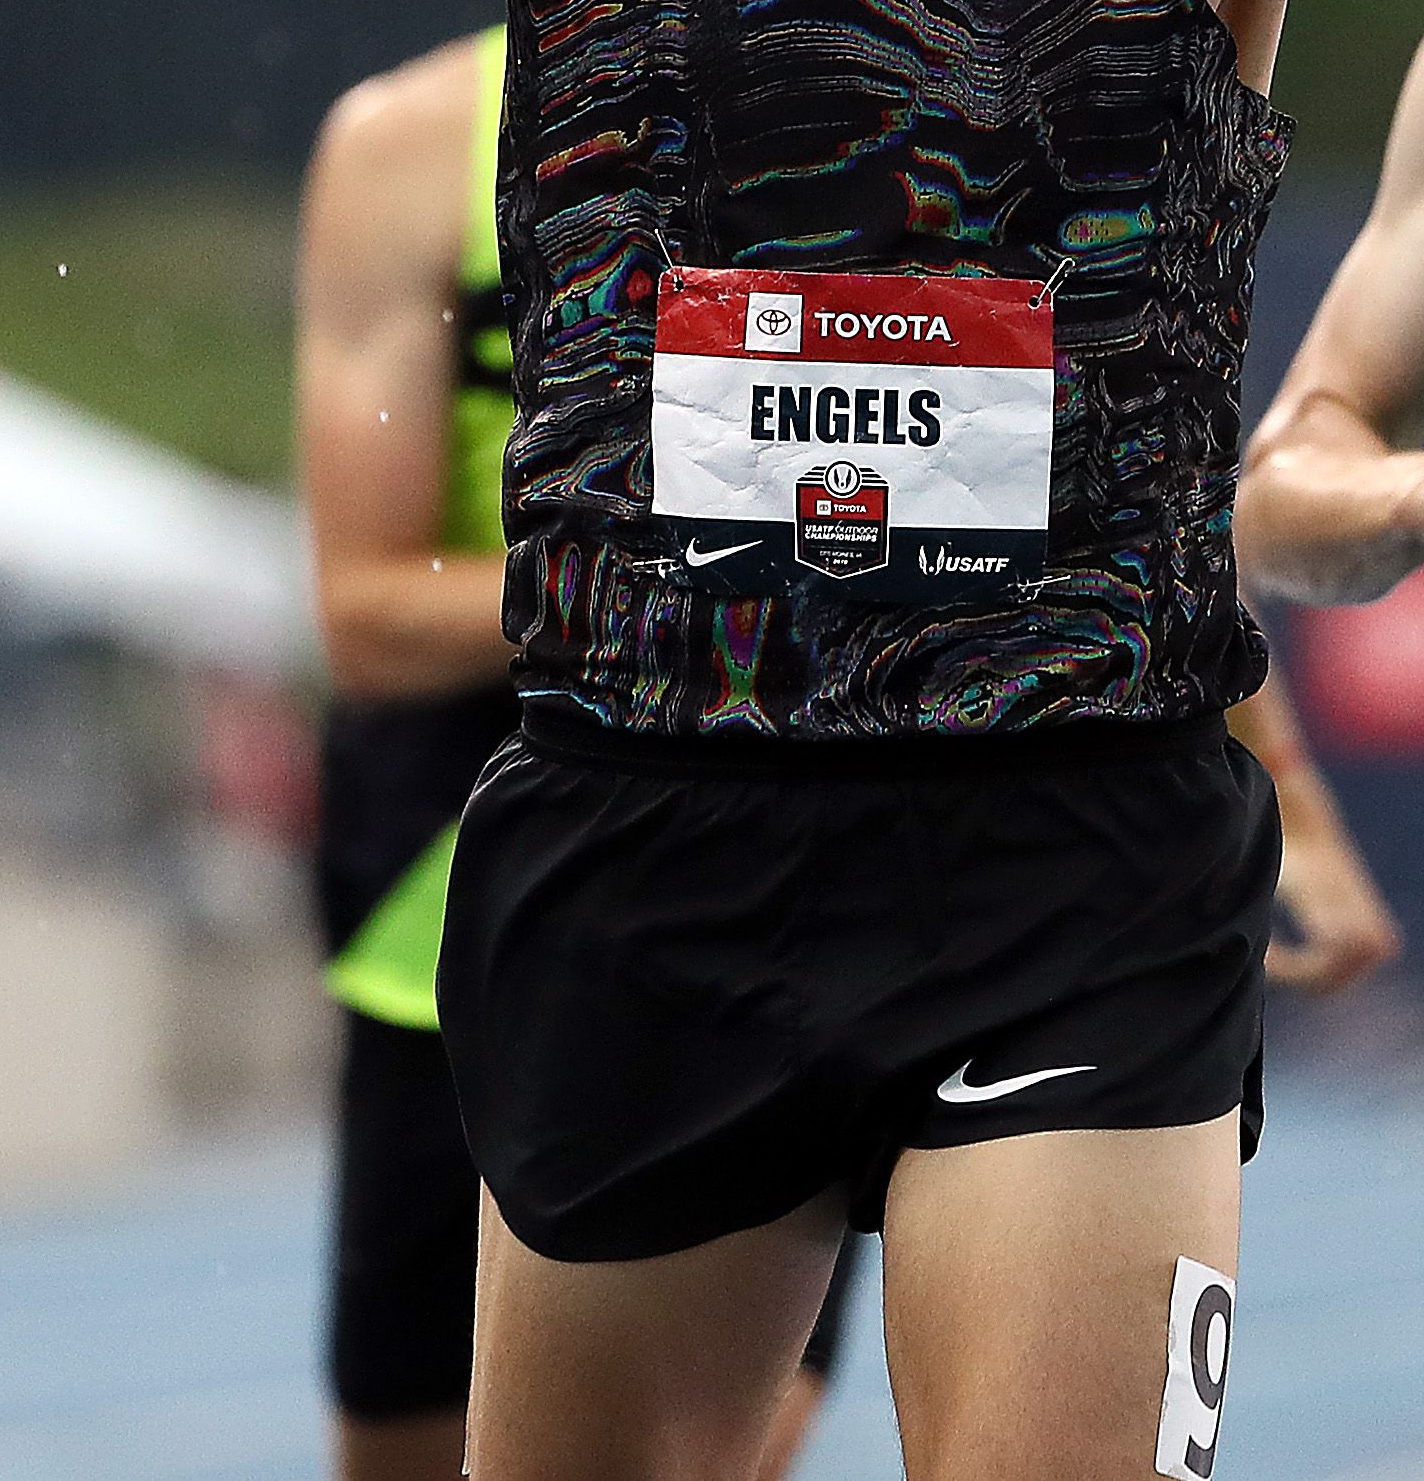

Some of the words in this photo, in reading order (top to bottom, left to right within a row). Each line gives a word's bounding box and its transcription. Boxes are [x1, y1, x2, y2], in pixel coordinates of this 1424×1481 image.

[813, 312, 952, 341] TOYOTA
[750, 384, 942, 447] ENGELS
[833, 504, 867, 513] TOYOTA
[804, 532, 878, 543] CHAMPIONSHIPS
[945, 556, 1010, 573] USATF
[1184, 1284, 1232, 1480] 9
